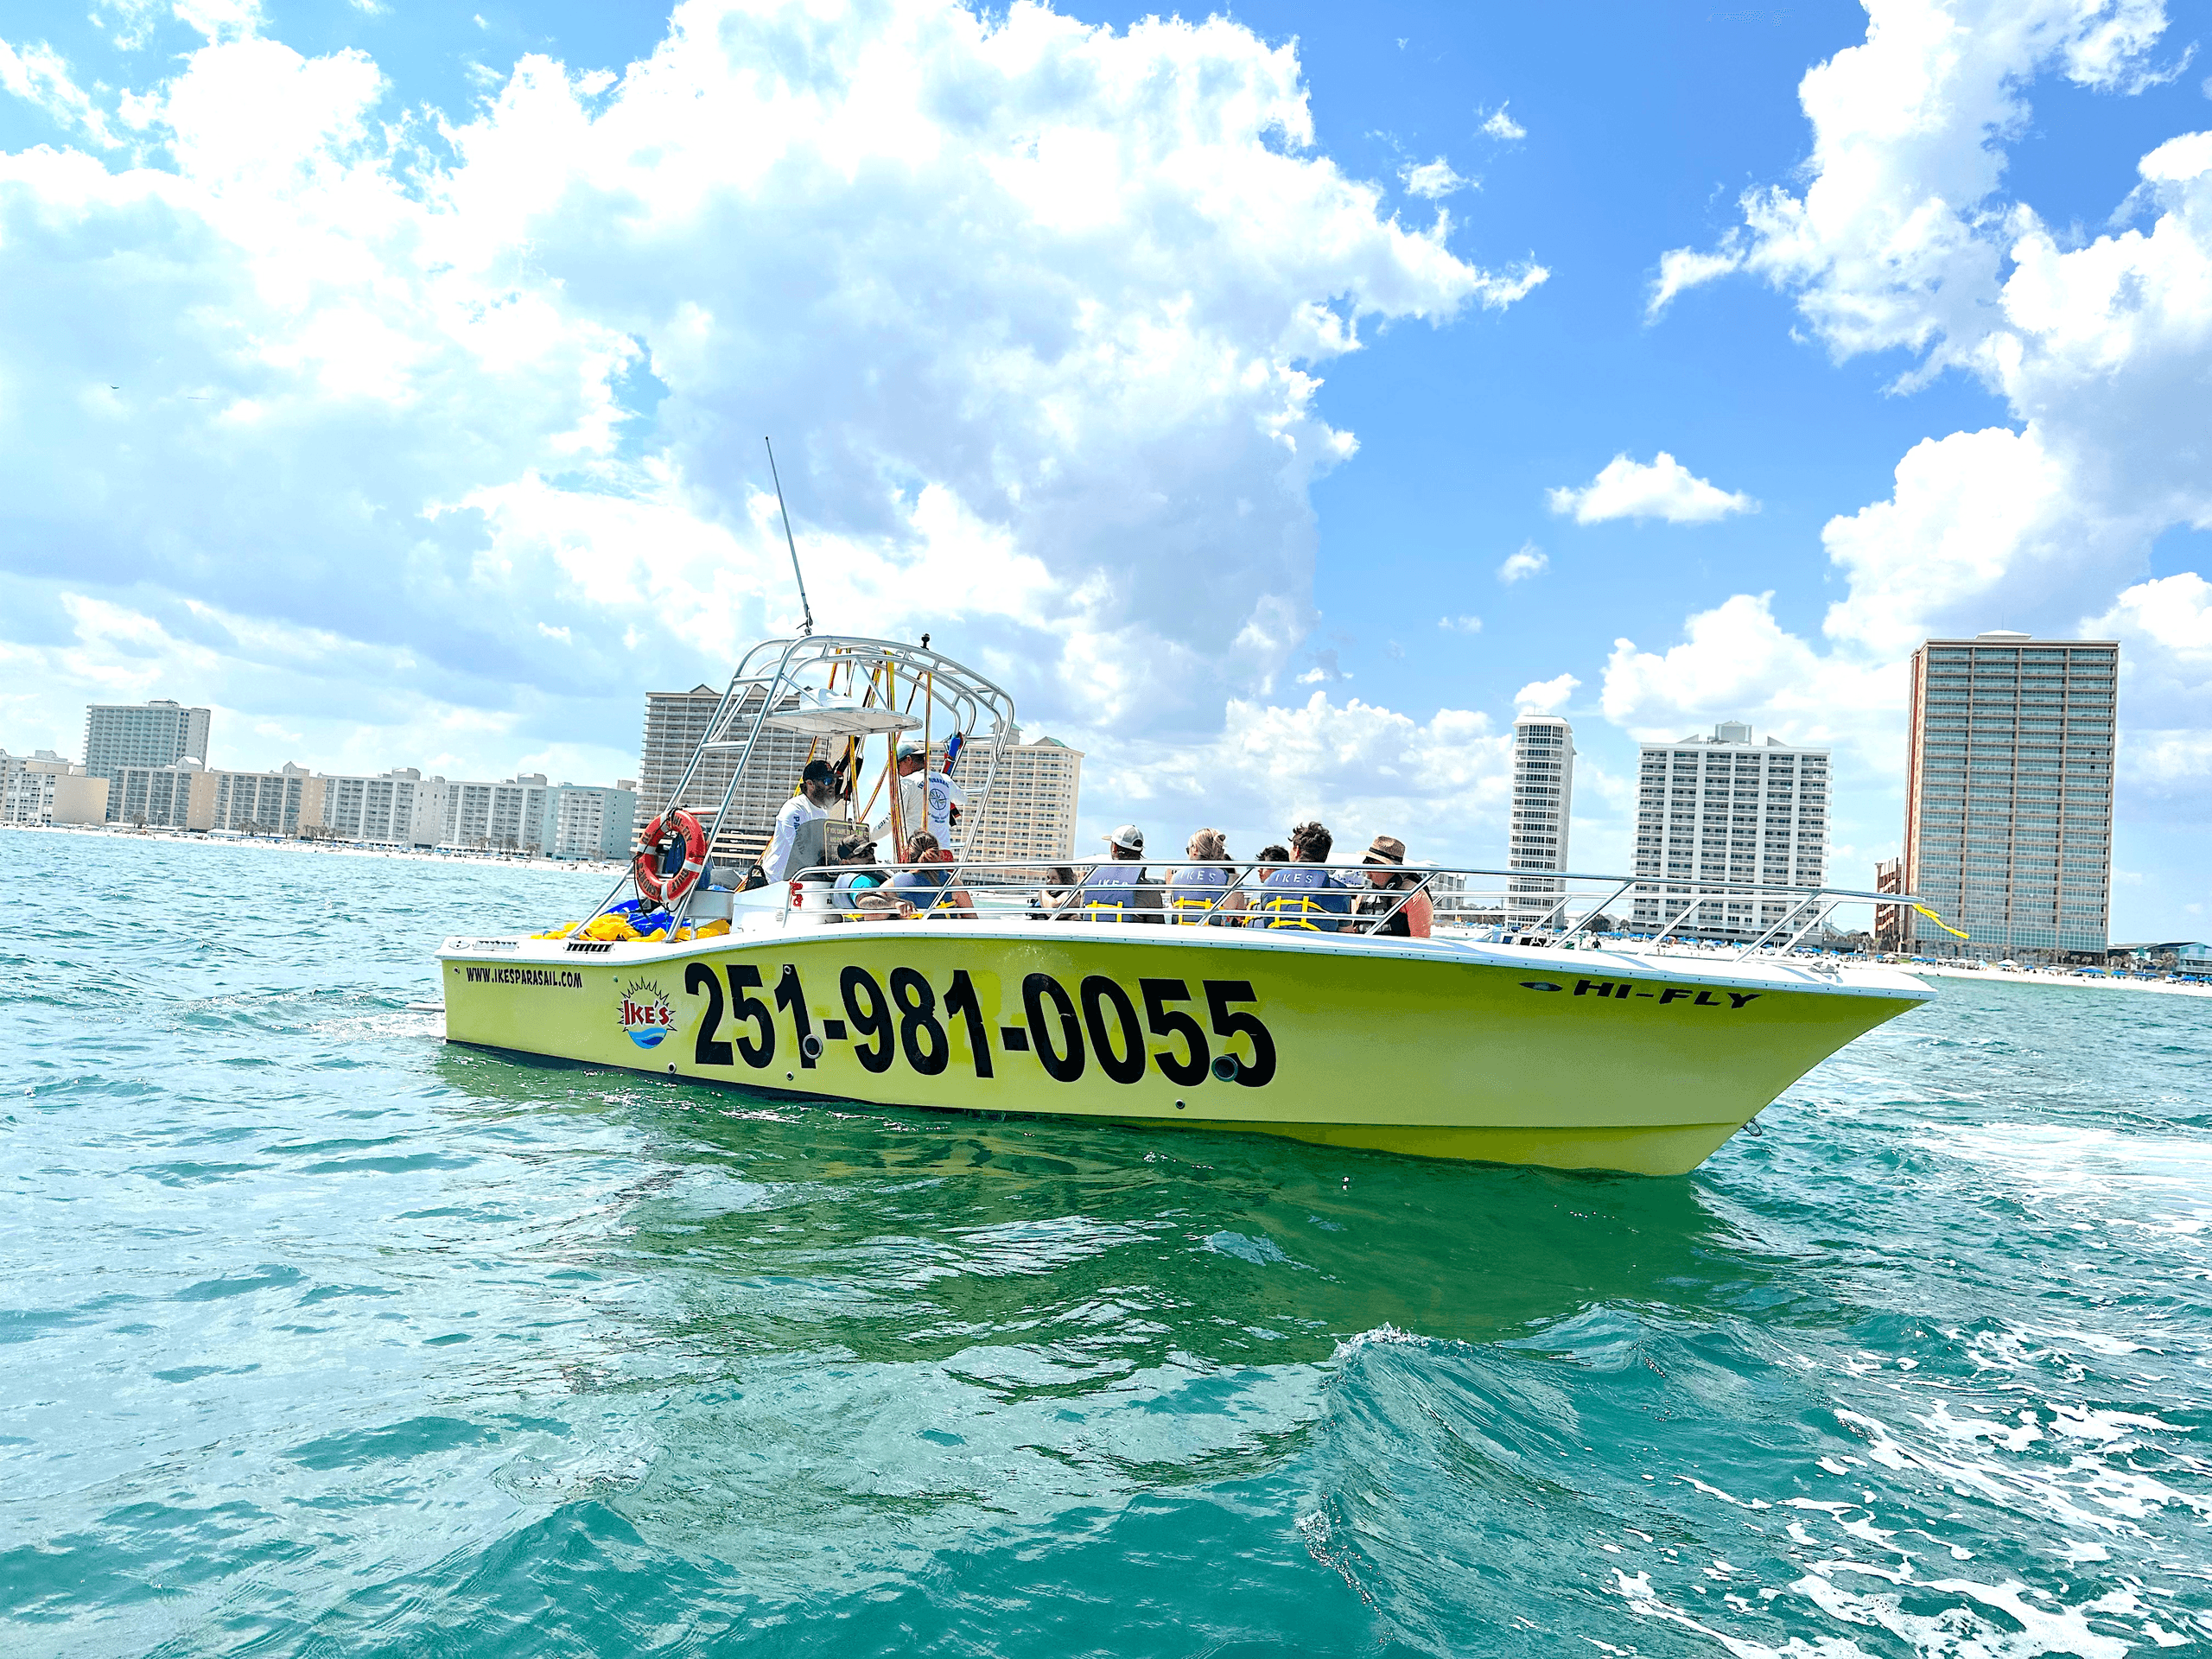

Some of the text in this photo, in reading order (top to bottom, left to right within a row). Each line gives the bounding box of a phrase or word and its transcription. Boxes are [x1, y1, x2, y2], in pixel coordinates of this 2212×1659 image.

[1180, 871, 1216, 882] IKES
[1274, 873, 1313, 884] IKES
[466, 967, 583, 988] WWW.IKESPARASAIL.COM
[1573, 979, 1763, 1009] HI-FLY
[684, 962, 1277, 1088] 251-981-0055
